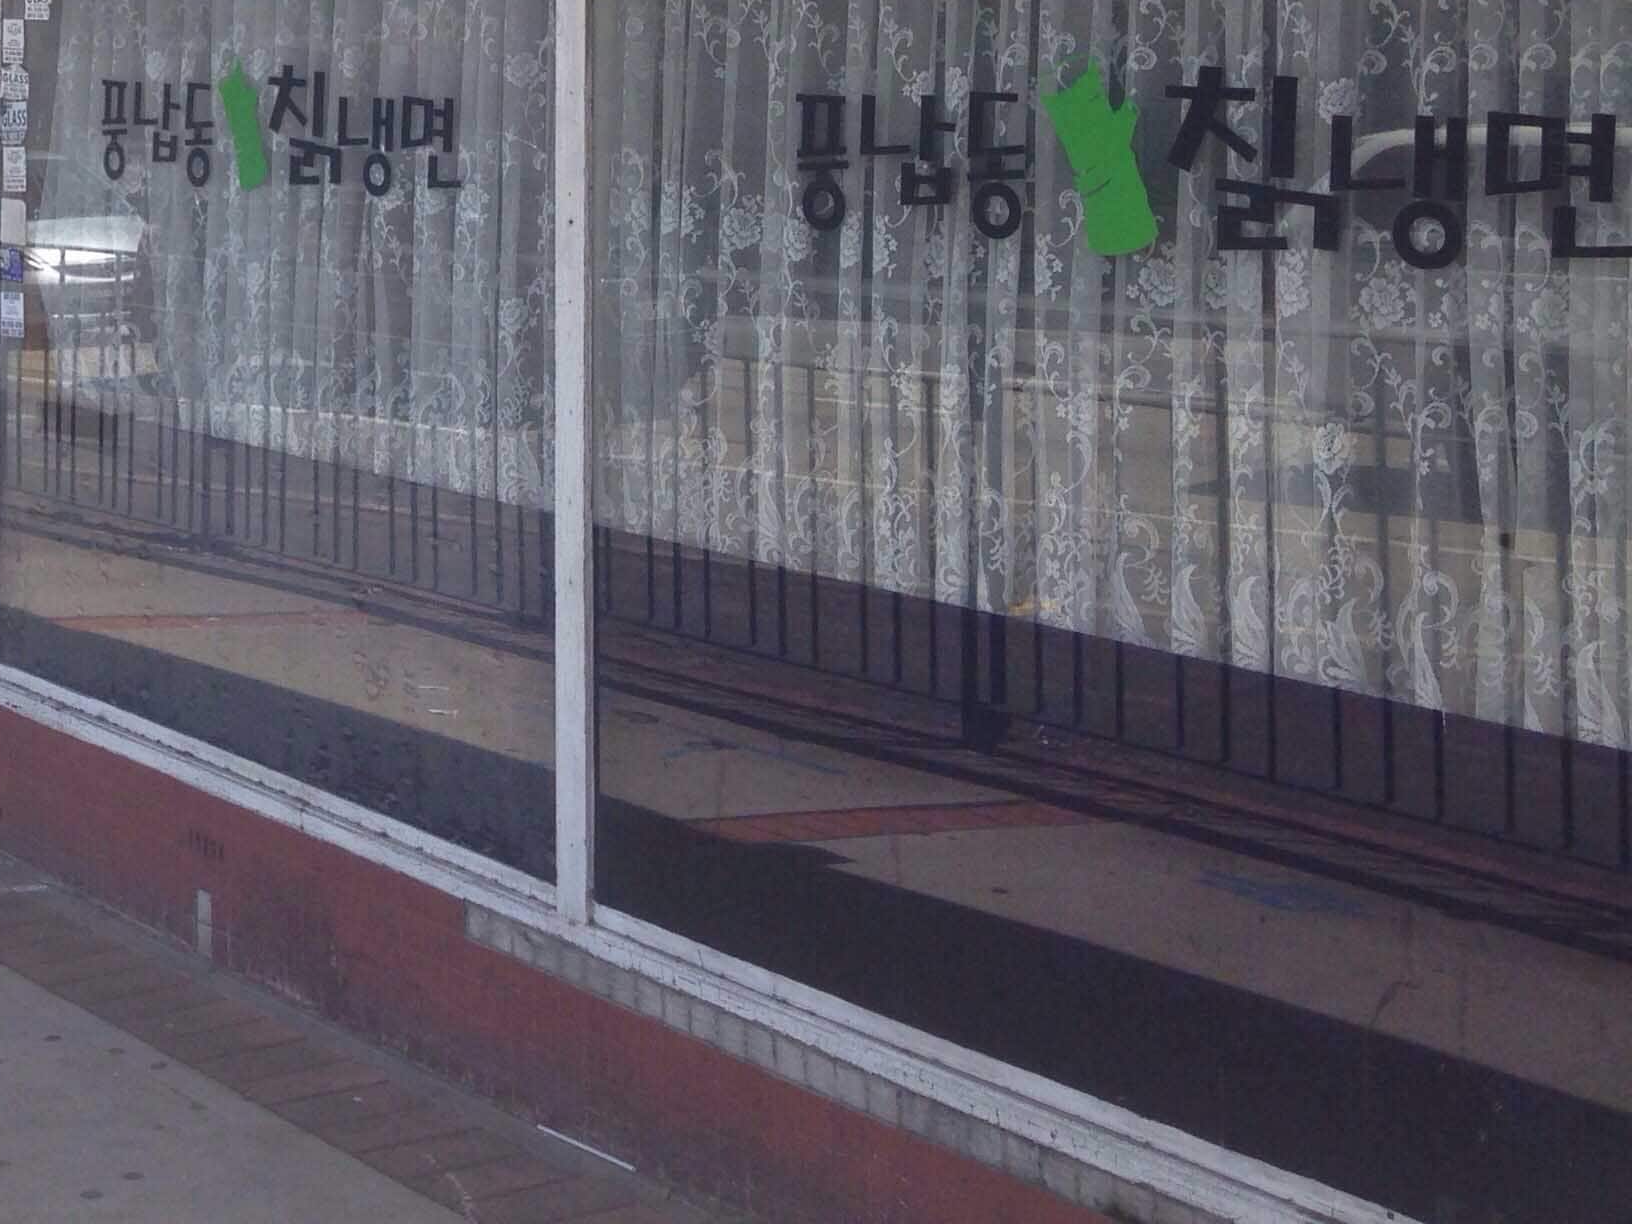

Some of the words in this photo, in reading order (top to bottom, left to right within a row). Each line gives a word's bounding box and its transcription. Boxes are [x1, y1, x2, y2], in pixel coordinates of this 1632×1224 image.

[101, 79, 215, 188] 풍납동
[268, 64, 462, 197] 칡냉면
[796, 91, 1026, 240] 풍납동
[1165, 64, 1632, 270] 칡냉면
